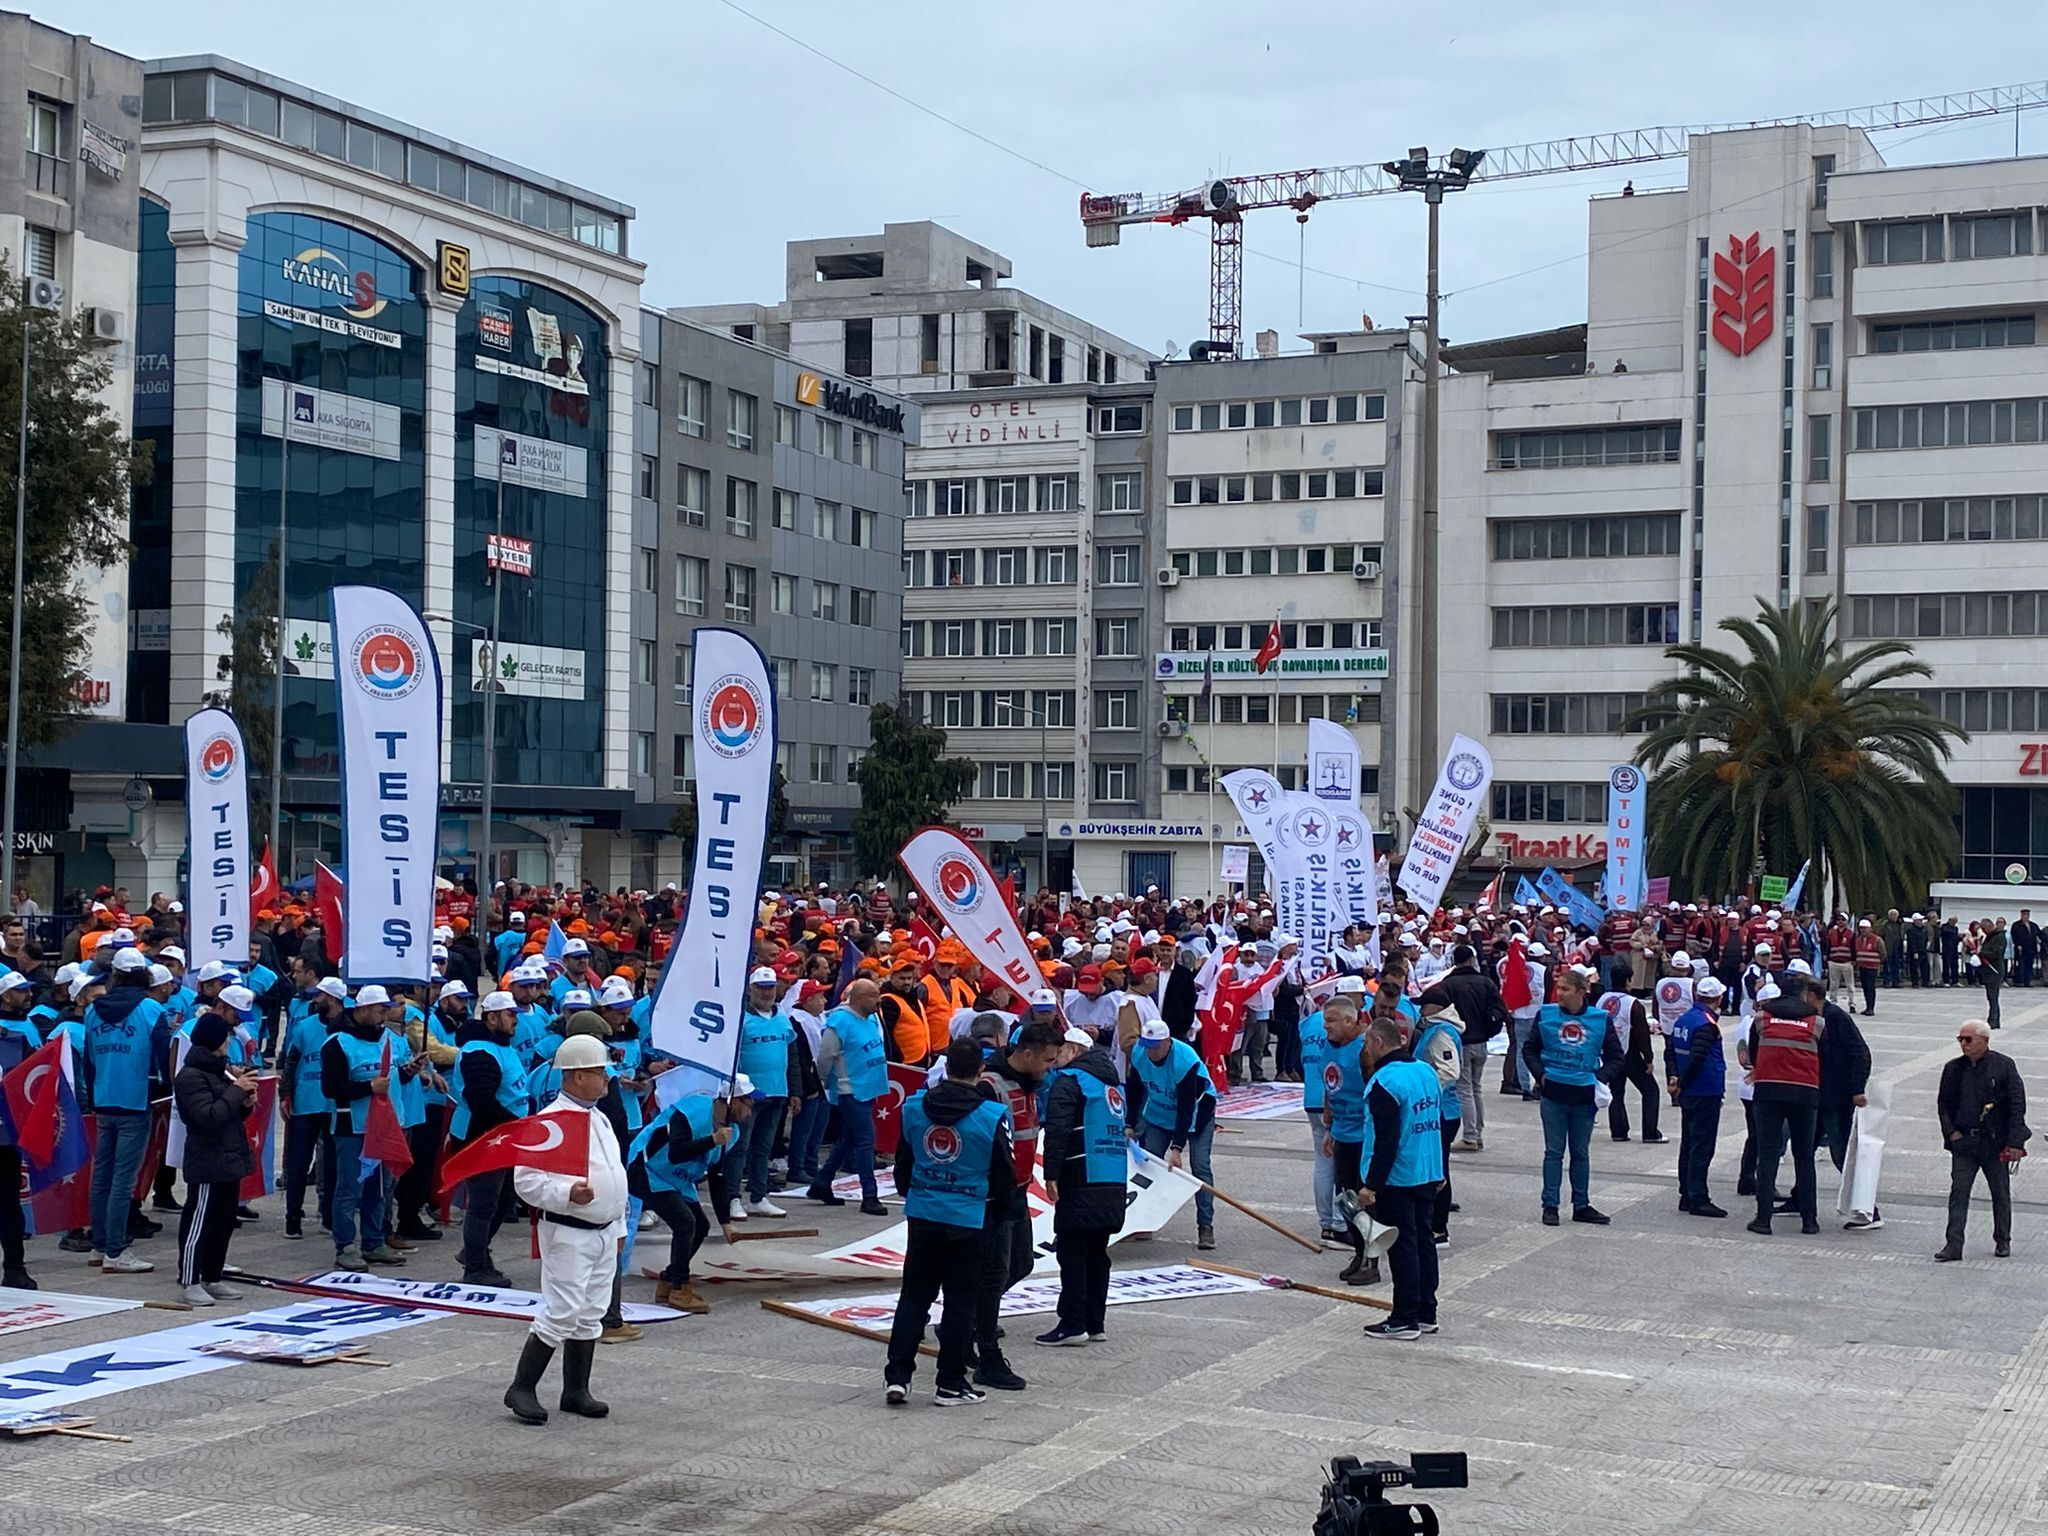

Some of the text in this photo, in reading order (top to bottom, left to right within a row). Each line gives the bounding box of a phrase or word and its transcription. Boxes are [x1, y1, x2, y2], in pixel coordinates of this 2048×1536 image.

[282, 258, 376, 309] KANAL S
[325, 318, 341, 331] TEK
[483, 332, 510, 347] HABER
[970, 401, 1036, 418] OTEL
[317, 412, 372, 433] AXA SİGORTA
[947, 419, 1060, 444] VİDİNLİ
[522, 444, 562, 462] AXA HAYAT
[489, 534, 530, 552] KRALIK
[1227, 658, 1257, 673] KÜLTÜ
[1282, 658, 1341, 674] DAYANIŞMA
[1343, 655, 1388, 672] DERNEĞİ
[453, 789, 482, 801] PLAZ
[1079, 822, 1204, 837] BÜYÜKŞEHİR ZABITA
[375, 732, 412, 958] TES-İŞ
[211, 801, 235, 949] TES-İŞ
[688, 792, 741, 1042] TES-İŞ
